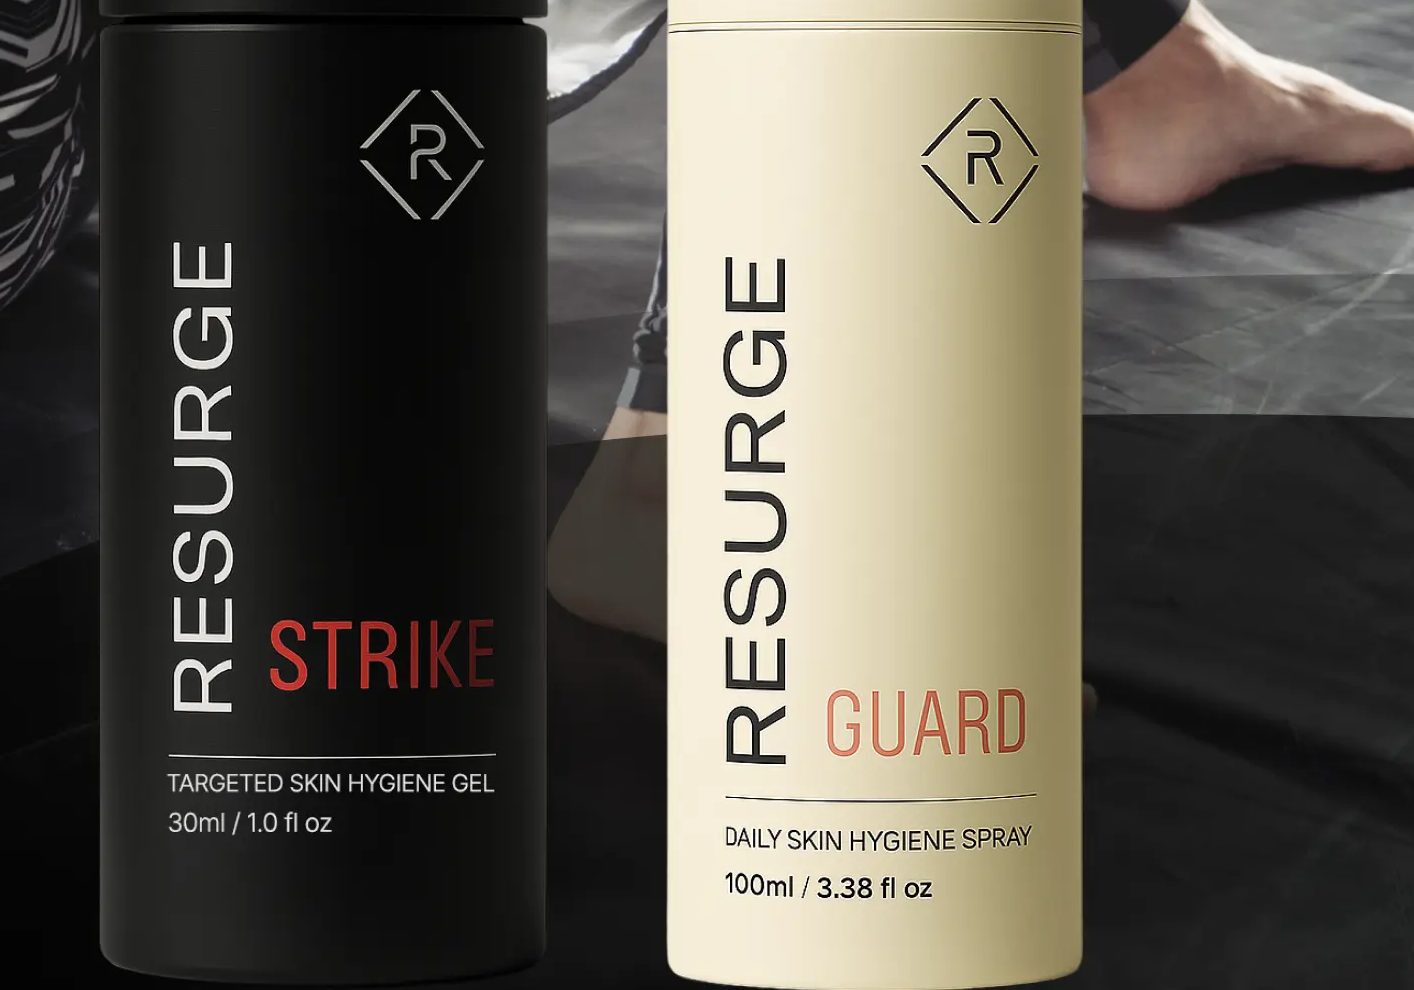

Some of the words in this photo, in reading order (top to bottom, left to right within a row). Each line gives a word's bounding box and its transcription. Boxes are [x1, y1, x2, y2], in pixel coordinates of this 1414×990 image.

[172, 241, 234, 713] RESURGE
[722, 256, 787, 765] RESURGE
[268, 618, 496, 692] STRIKE
[824, 687, 1028, 758] GUARD
[167, 773, 284, 793] TARGETED
[289, 773, 341, 793] SKIN
[348, 773, 446, 793] HYGIENE
[451, 773, 495, 793] GEL
[168, 811, 226, 834] 30ml
[231, 811, 241, 836] /
[246, 812, 278, 834] 1.0
[284, 811, 298, 834] fl
[305, 816, 332, 834] oz
[725, 825, 782, 850] DAILY
[787, 828, 842, 852] SKIN
[849, 829, 956, 852] HYGIENE
[961, 824, 1033, 850] SPRAY
[724, 871, 794, 898] 100ml
[801, 875, 810, 899] /
[816, 876, 873, 899] 3.38
[880, 876, 896, 899] fl
[903, 880, 933, 899] oz
